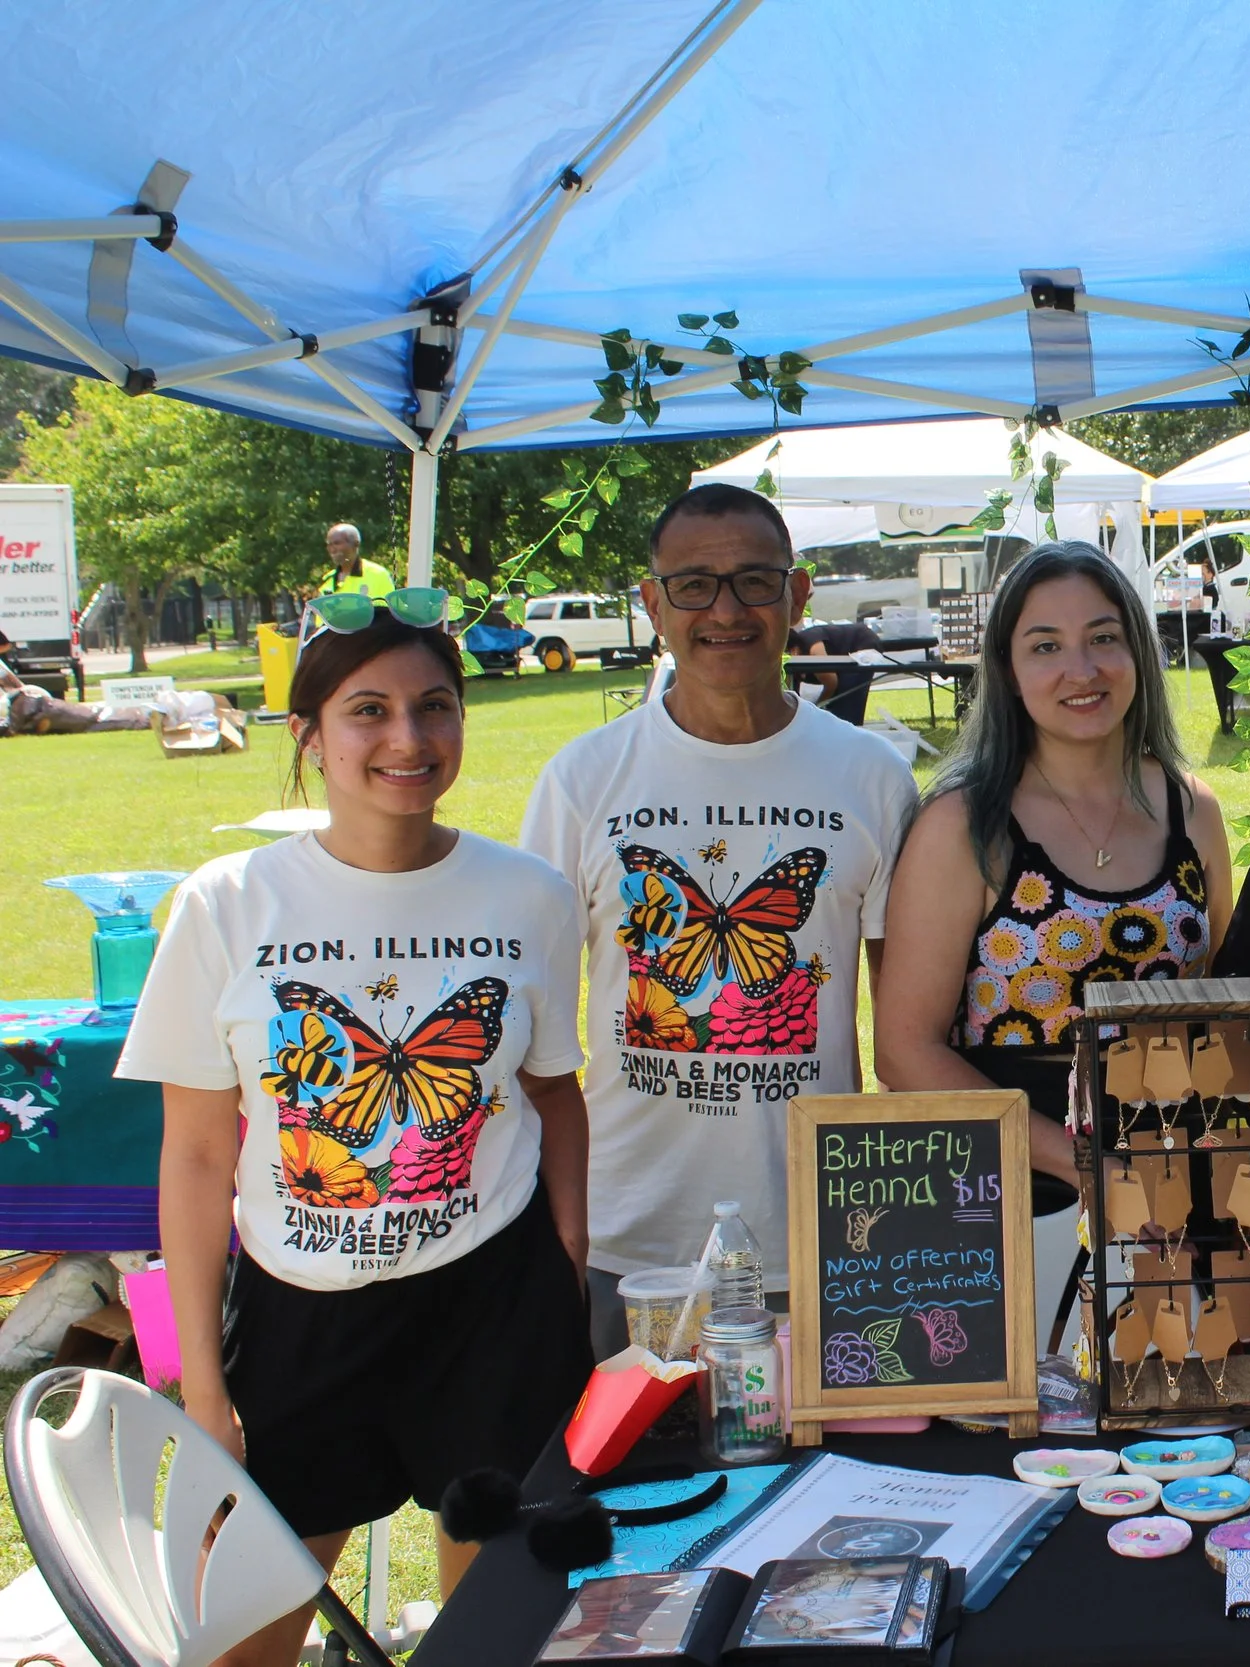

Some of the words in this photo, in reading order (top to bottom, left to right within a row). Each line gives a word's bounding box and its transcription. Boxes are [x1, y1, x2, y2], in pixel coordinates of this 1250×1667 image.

[706, 806, 844, 832] ILLINOIS
[375, 937, 521, 961] ILLINOIS
[614, 1009, 626, 1046] 2024
[620, 1051, 680, 1080] ZINNIA
[689, 1060, 704, 1081] &
[713, 1059, 821, 1082] MONARCH
[627, 1074, 668, 1096] AND
[676, 1080, 741, 1102] BEES
[751, 1081, 800, 1103] TOO
[688, 1103, 739, 1117] FESTIVAL
[827, 1174, 938, 1208] Henna
[952, 1174, 1001, 1207] $15
[284, 1204, 355, 1238] ZINNIA
[283, 1229, 338, 1253] AND
[340, 1233, 408, 1255] BEES
[824, 1279, 883, 1302] Gift
[893, 1272, 1001, 1294] Certificates
[849, 1493, 957, 1512] Pricing
[870, 1481, 970, 1497] Henna
